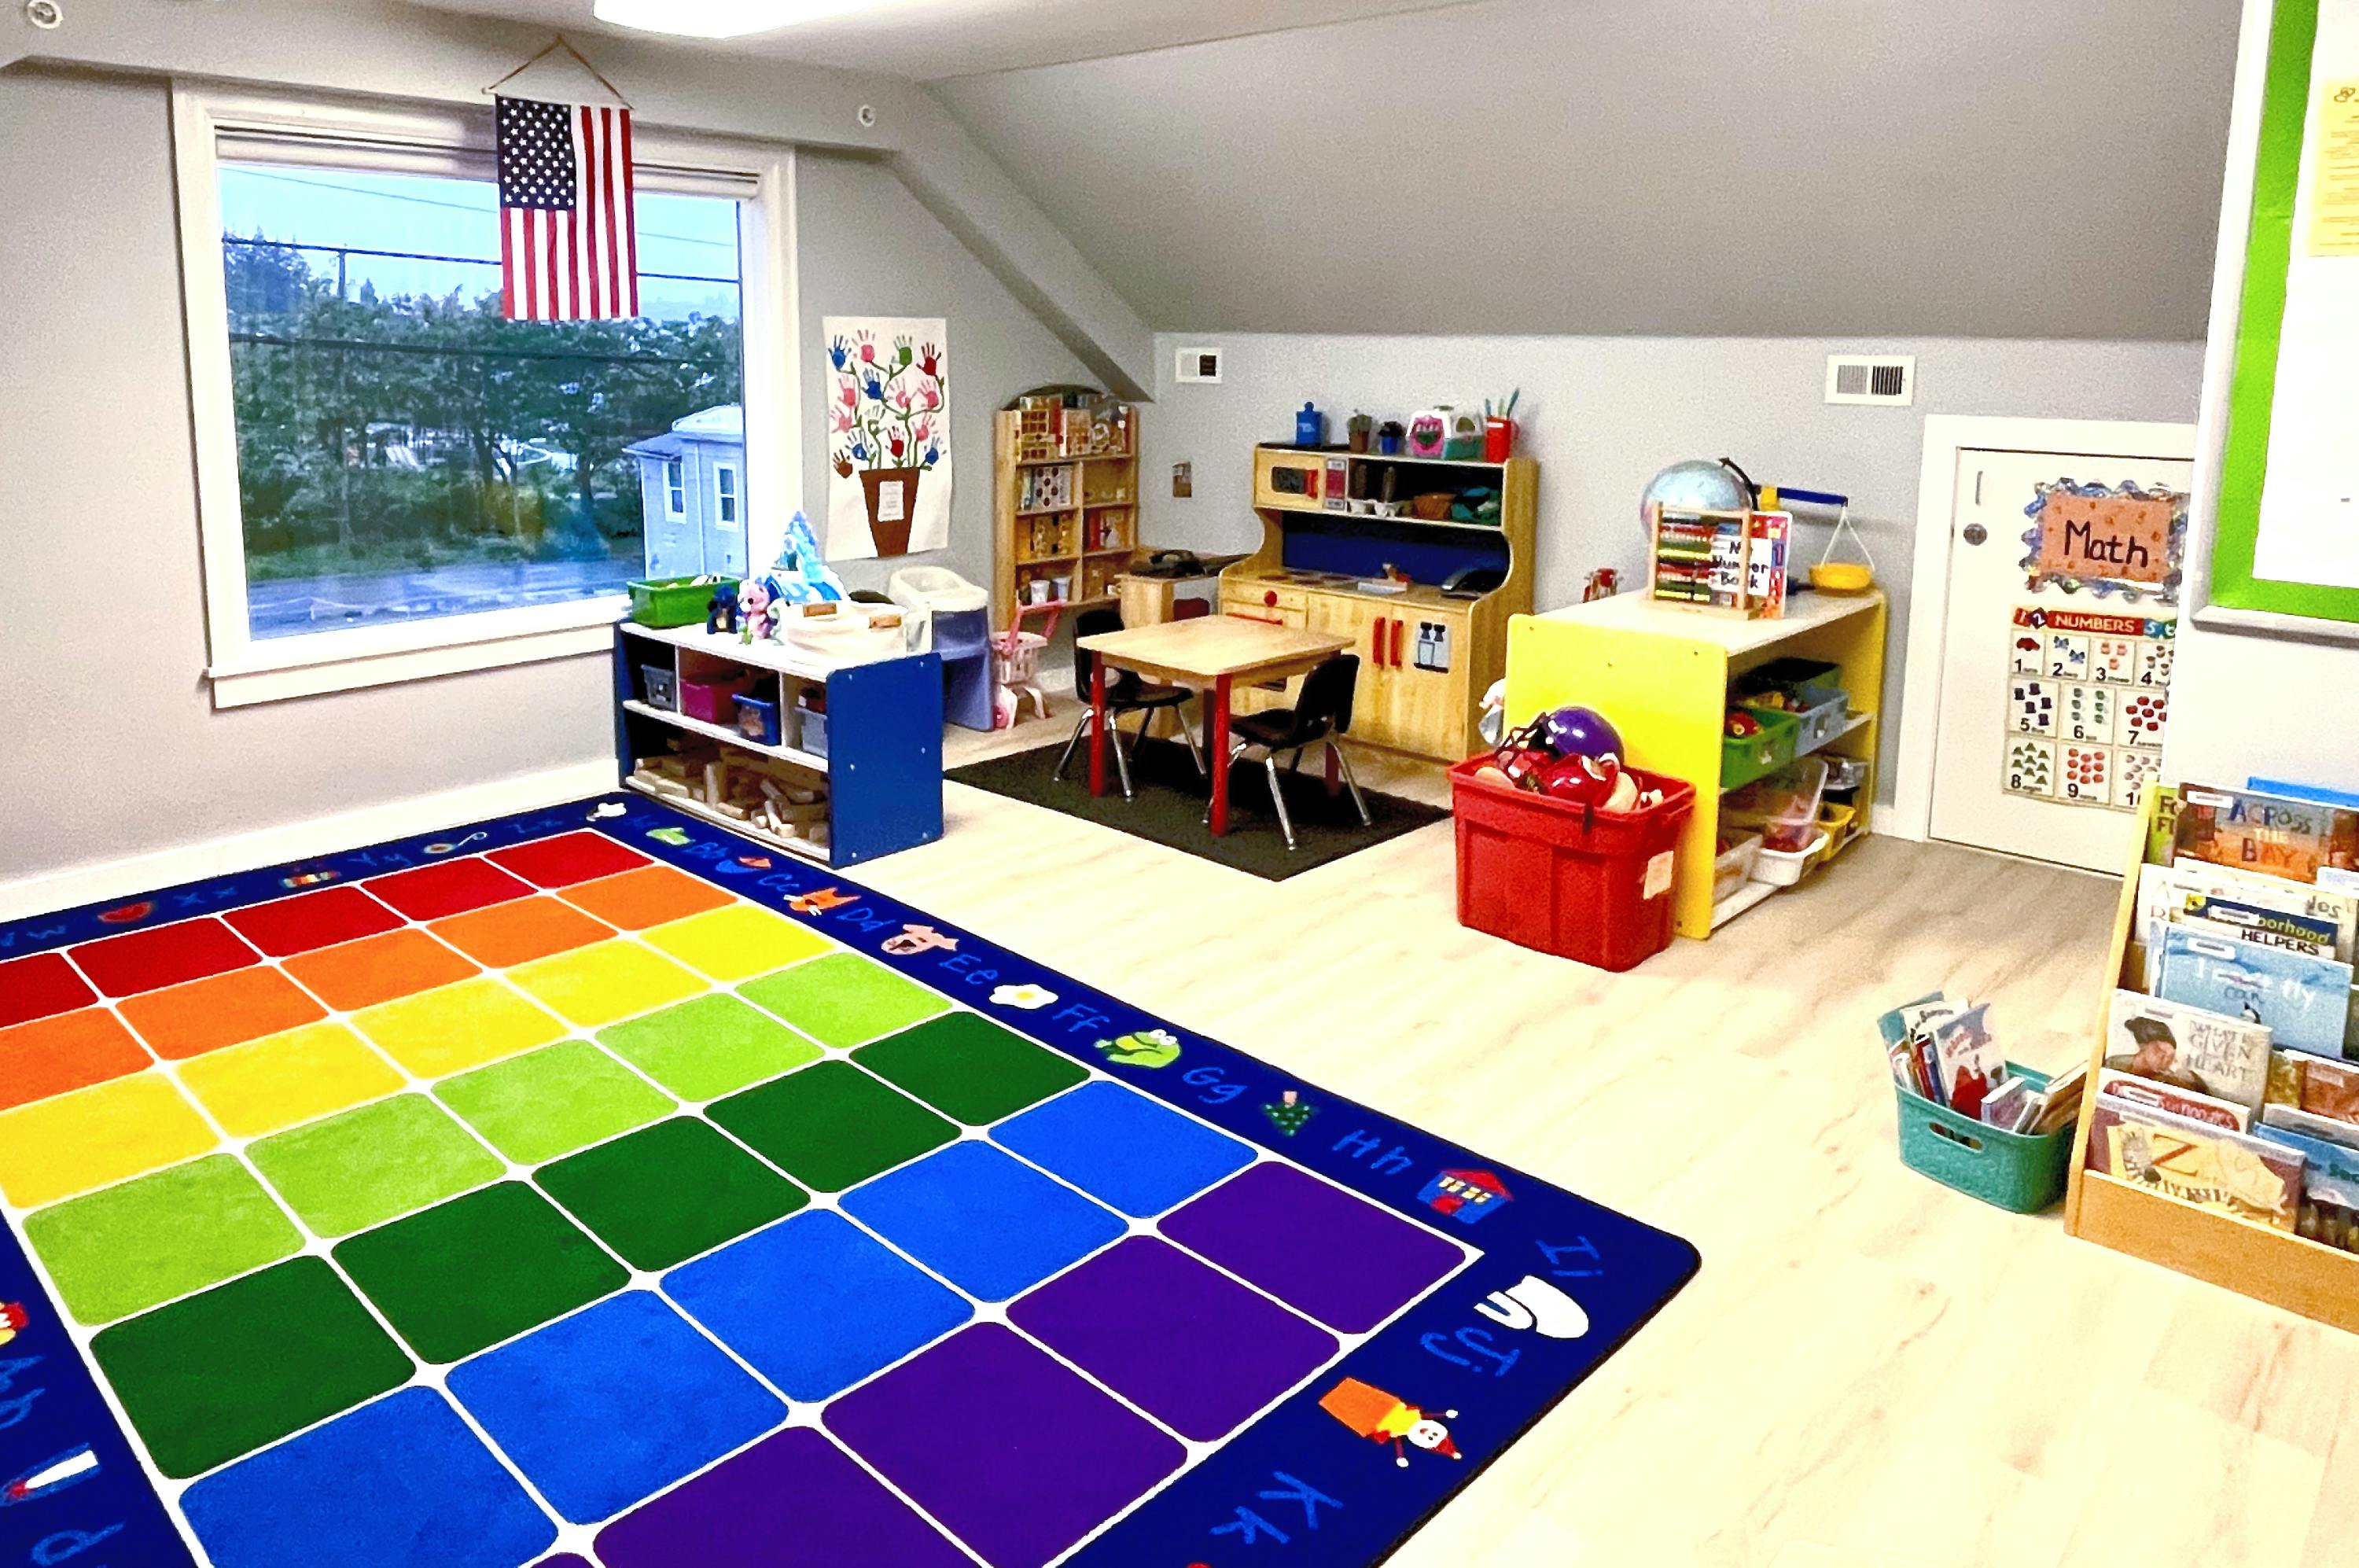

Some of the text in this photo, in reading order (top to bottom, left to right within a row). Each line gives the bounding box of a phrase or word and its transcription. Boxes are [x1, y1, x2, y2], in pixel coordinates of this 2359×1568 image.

[2064, 520, 2148, 568] Math
[2032, 613, 2044, 626] 2
[2055, 614, 2136, 632] NUMBERS
[2145, 621, 2157, 633] 5
[2015, 659, 2022, 673] 1
[2052, 663, 2063, 676] 2
[2096, 667, 2107, 681] 3
[2140, 672, 2152, 685] 4
[2020, 718, 2030, 731] 5
[2074, 725, 2084, 739] 6
[2128, 731, 2139, 745] 7
[2011, 775, 2021, 789] 8
[2067, 783, 2079, 798] 9
[2226, 799, 2313, 835] ACROSS
[2254, 827, 2289, 844] THE
[2241, 837, 2295, 867] BAY
[835, 907, 896, 933] Dd
[2241, 929, 2319, 955] HELPERS
[938, 954, 999, 985] Ee
[1052, 1003, 1110, 1032] Ff
[1182, 1066, 1248, 1104] Gg
[1331, 1129, 1413, 1176] Hh
[2151, 1133, 2199, 1176] Z
[1420, 1327, 1522, 1377] Jj
[1209, 1470, 1345, 1545] Kk
